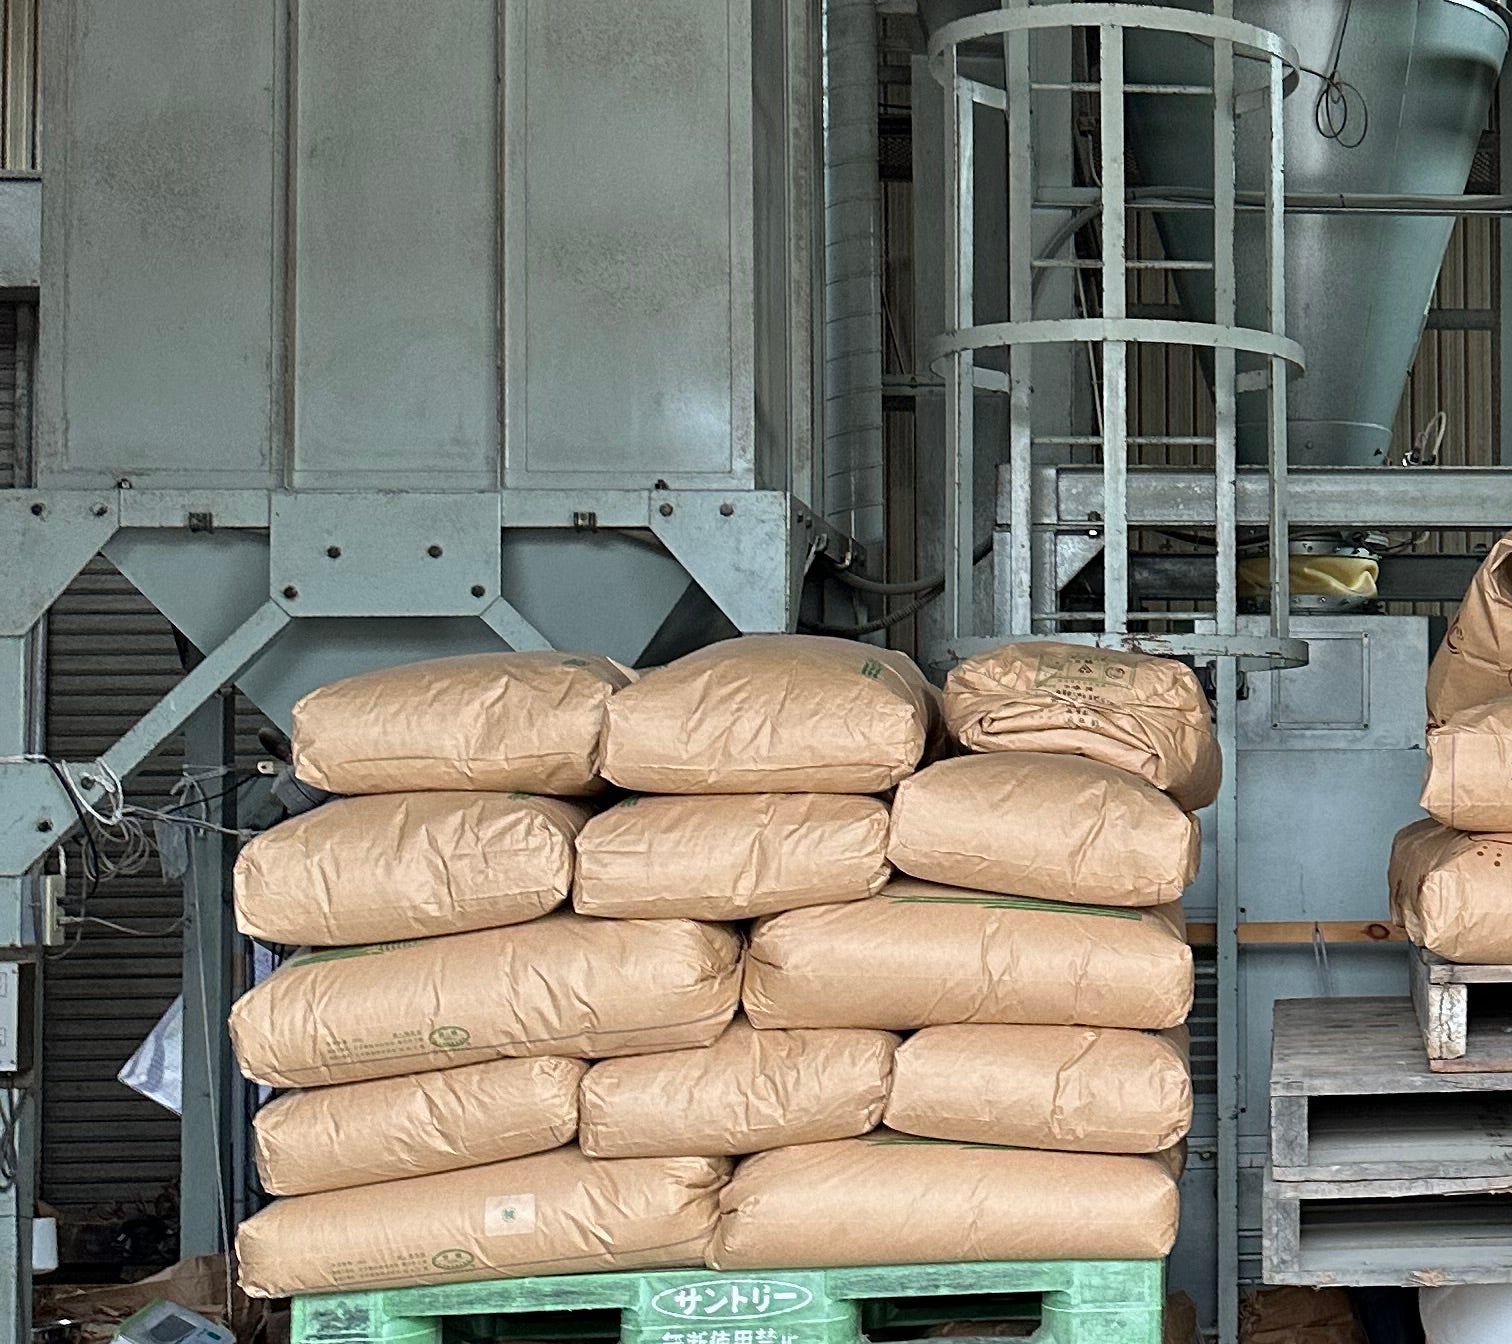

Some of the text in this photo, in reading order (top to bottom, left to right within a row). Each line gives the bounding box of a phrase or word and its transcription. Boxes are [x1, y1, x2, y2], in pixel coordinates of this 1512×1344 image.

[674, 1285, 797, 1315] サントリー
